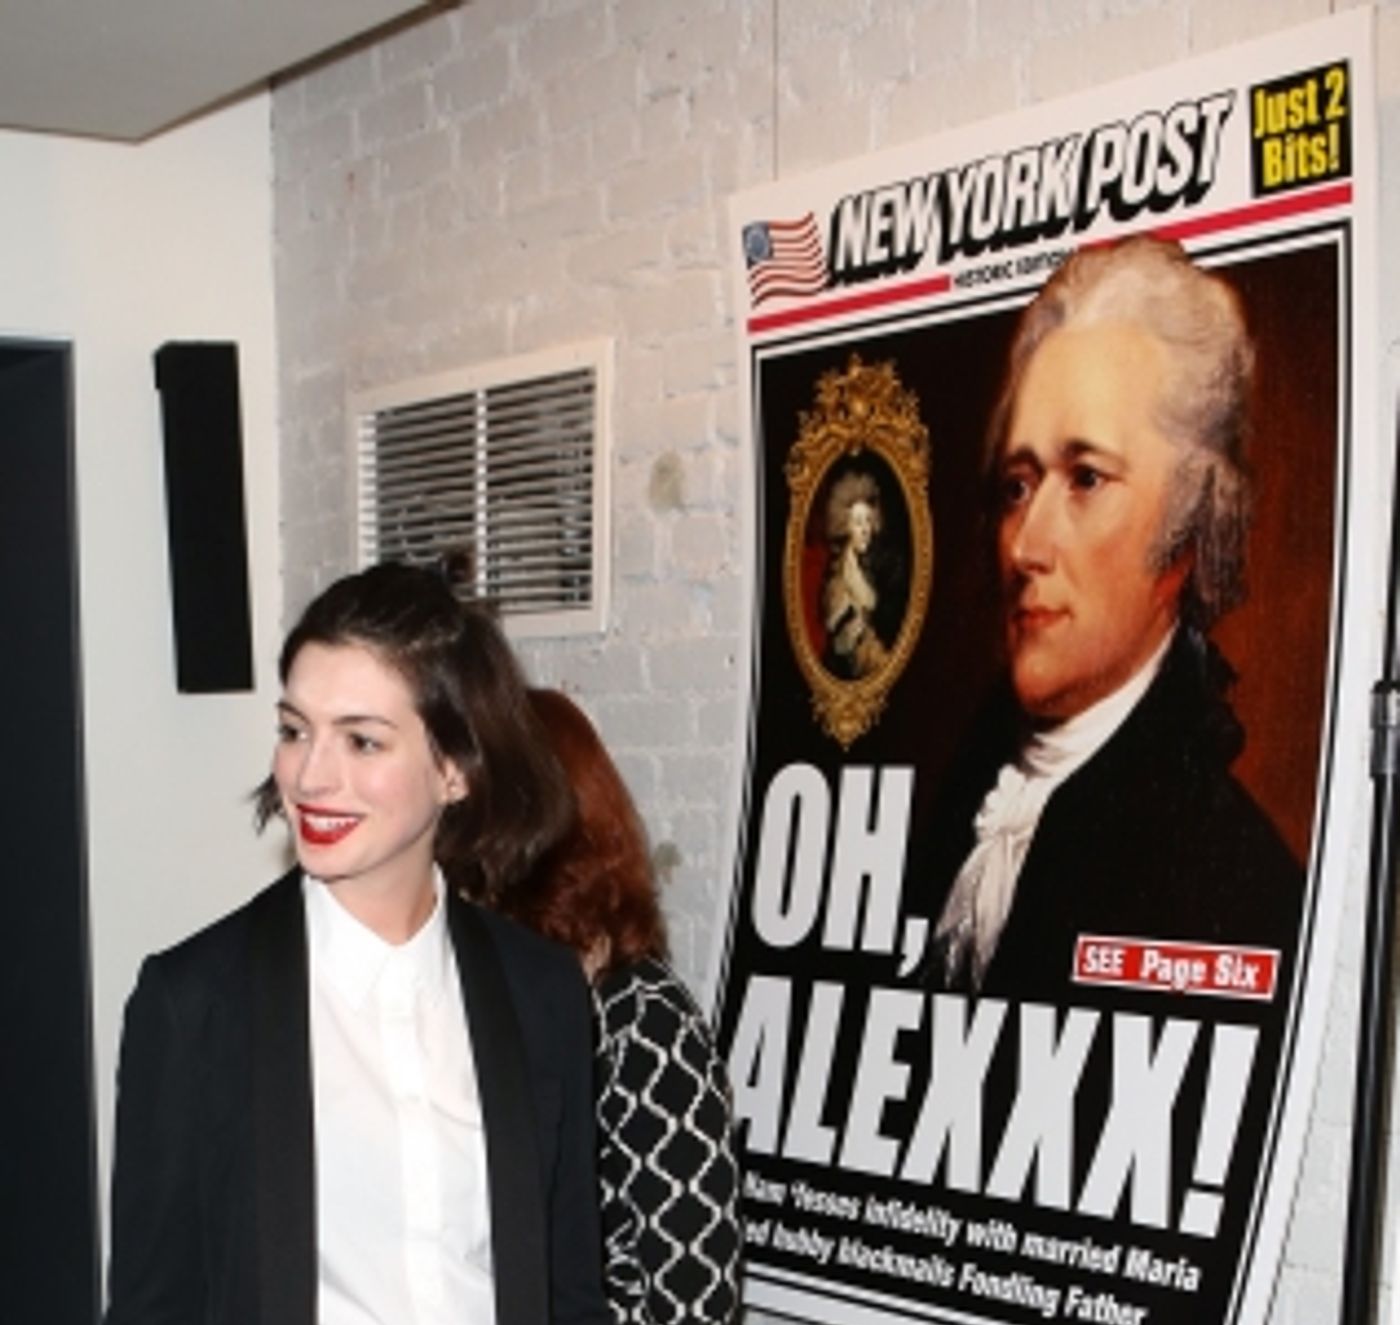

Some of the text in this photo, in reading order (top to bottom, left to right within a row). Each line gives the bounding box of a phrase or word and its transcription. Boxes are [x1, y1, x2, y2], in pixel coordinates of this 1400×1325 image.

[1254, 67, 1345, 139] Just 2
[826, 89, 1237, 286] NEW YORK POST
[1263, 123, 1339, 187] Bits!
[954, 261, 1013, 287] HISTORIC
[752, 762, 929, 977] OH,
[1083, 946, 1260, 990] SEE Page Six
[728, 975, 1260, 1239] ALEXXX!
[743, 1216, 771, 1247] ed
[772, 1221, 836, 1265] hubby
[837, 1236, 955, 1288] blackmails
[958, 1262, 1062, 1319] Fondling
[864, 1194, 963, 1247] infidelity
[966, 1218, 1017, 1254] with
[1021, 1232, 1123, 1274] married
[1124, 1247, 1200, 1292] Maria
